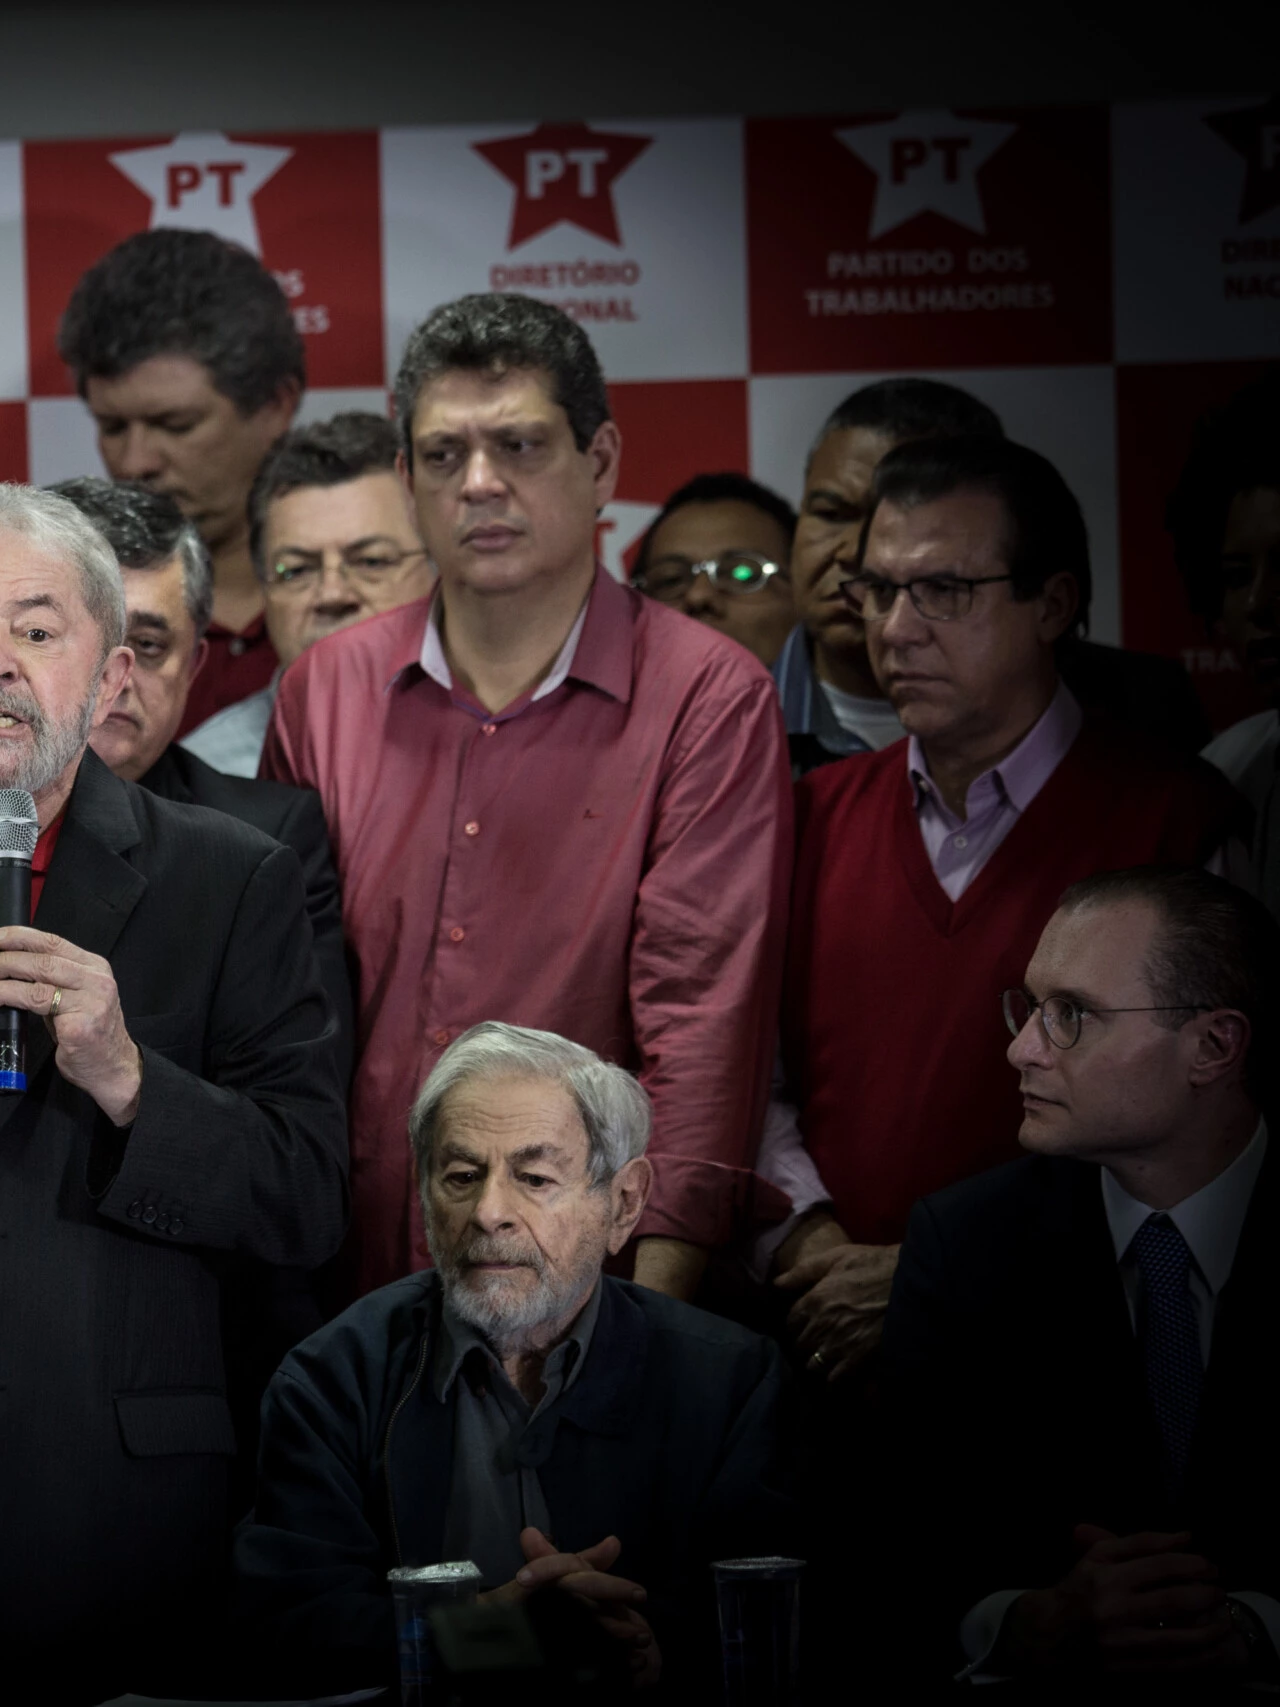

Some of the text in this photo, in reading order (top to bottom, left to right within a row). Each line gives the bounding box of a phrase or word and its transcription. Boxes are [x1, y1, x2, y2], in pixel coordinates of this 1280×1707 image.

[525, 148, 609, 200] PT
[892, 138, 970, 183] PT
[166, 162, 245, 208] PT
[826, 245, 1030, 279] PARTIDO DOS
[805, 281, 1057, 318] TRABALHADORES
